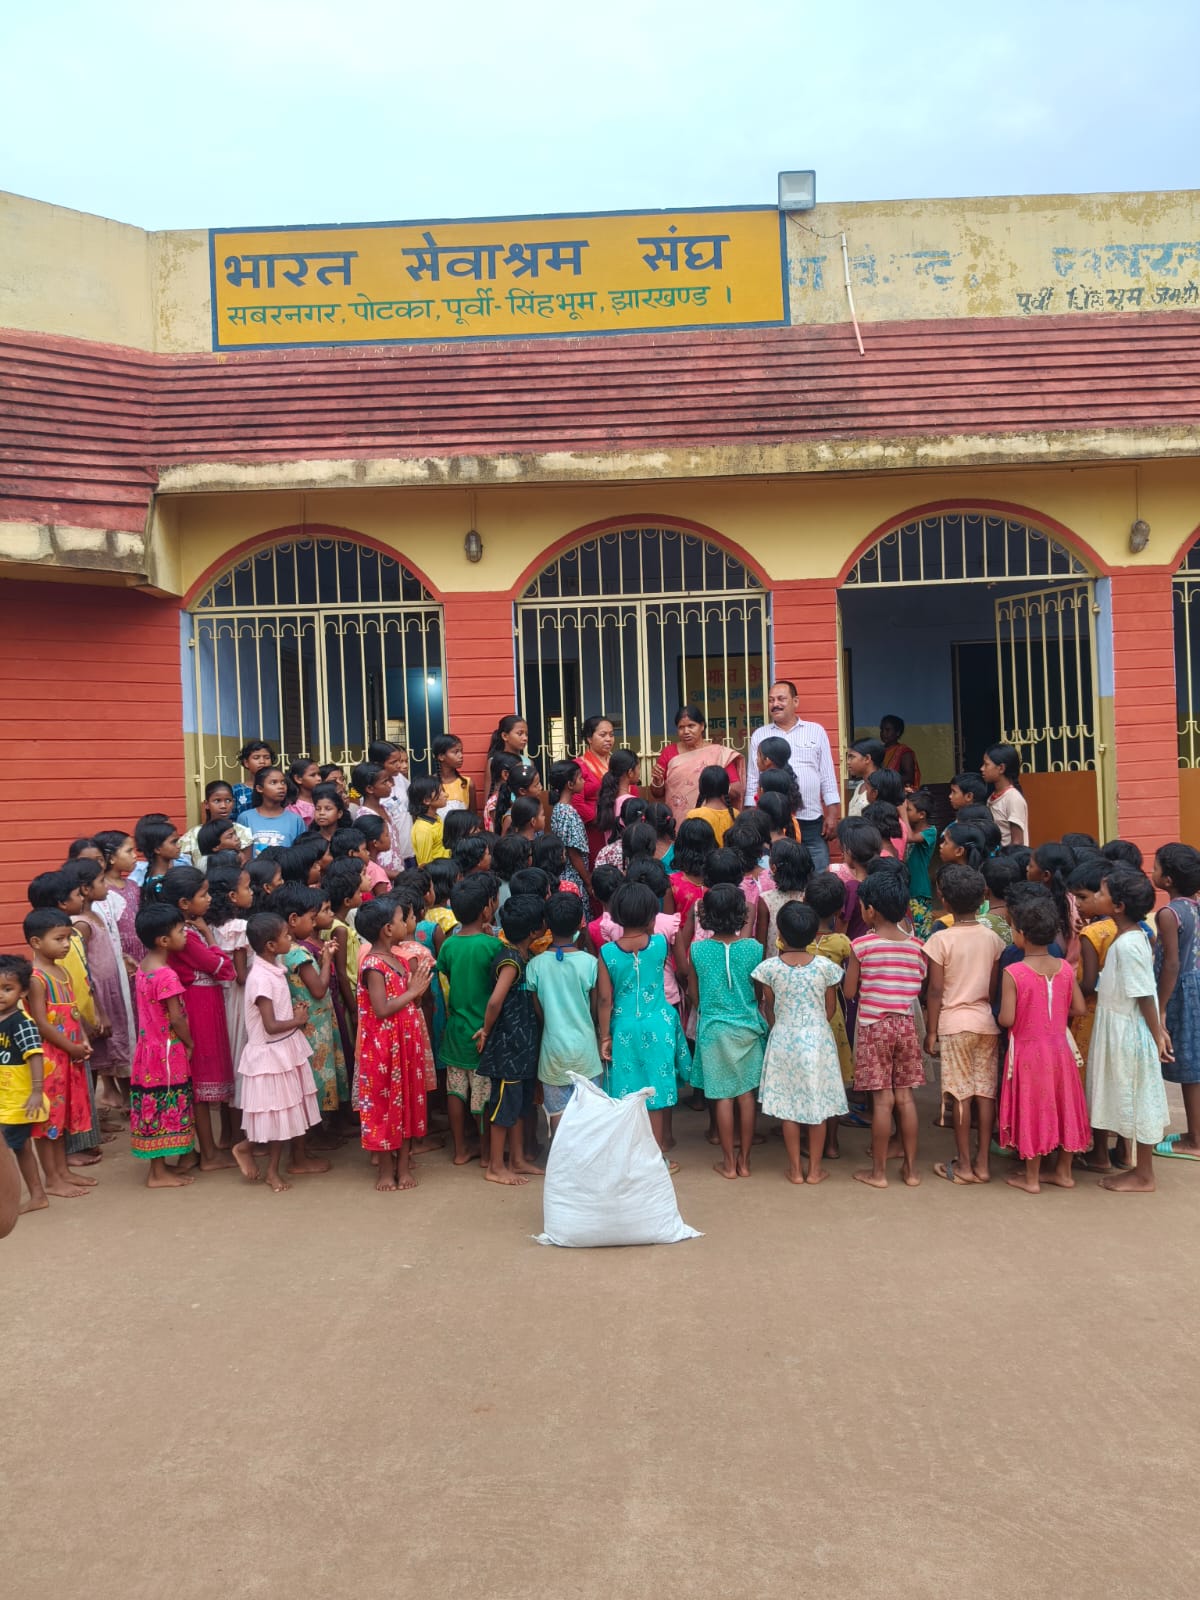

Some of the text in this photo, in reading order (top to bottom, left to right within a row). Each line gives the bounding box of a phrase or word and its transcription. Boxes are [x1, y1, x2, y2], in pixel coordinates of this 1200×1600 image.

[224, 224, 731, 289] भारत सेवाश्रम संघ
[227, 303, 346, 326] सबरनगर,
[348, 293, 441, 323] पोटका,
[608, 286, 711, 316] झारखण्ड
